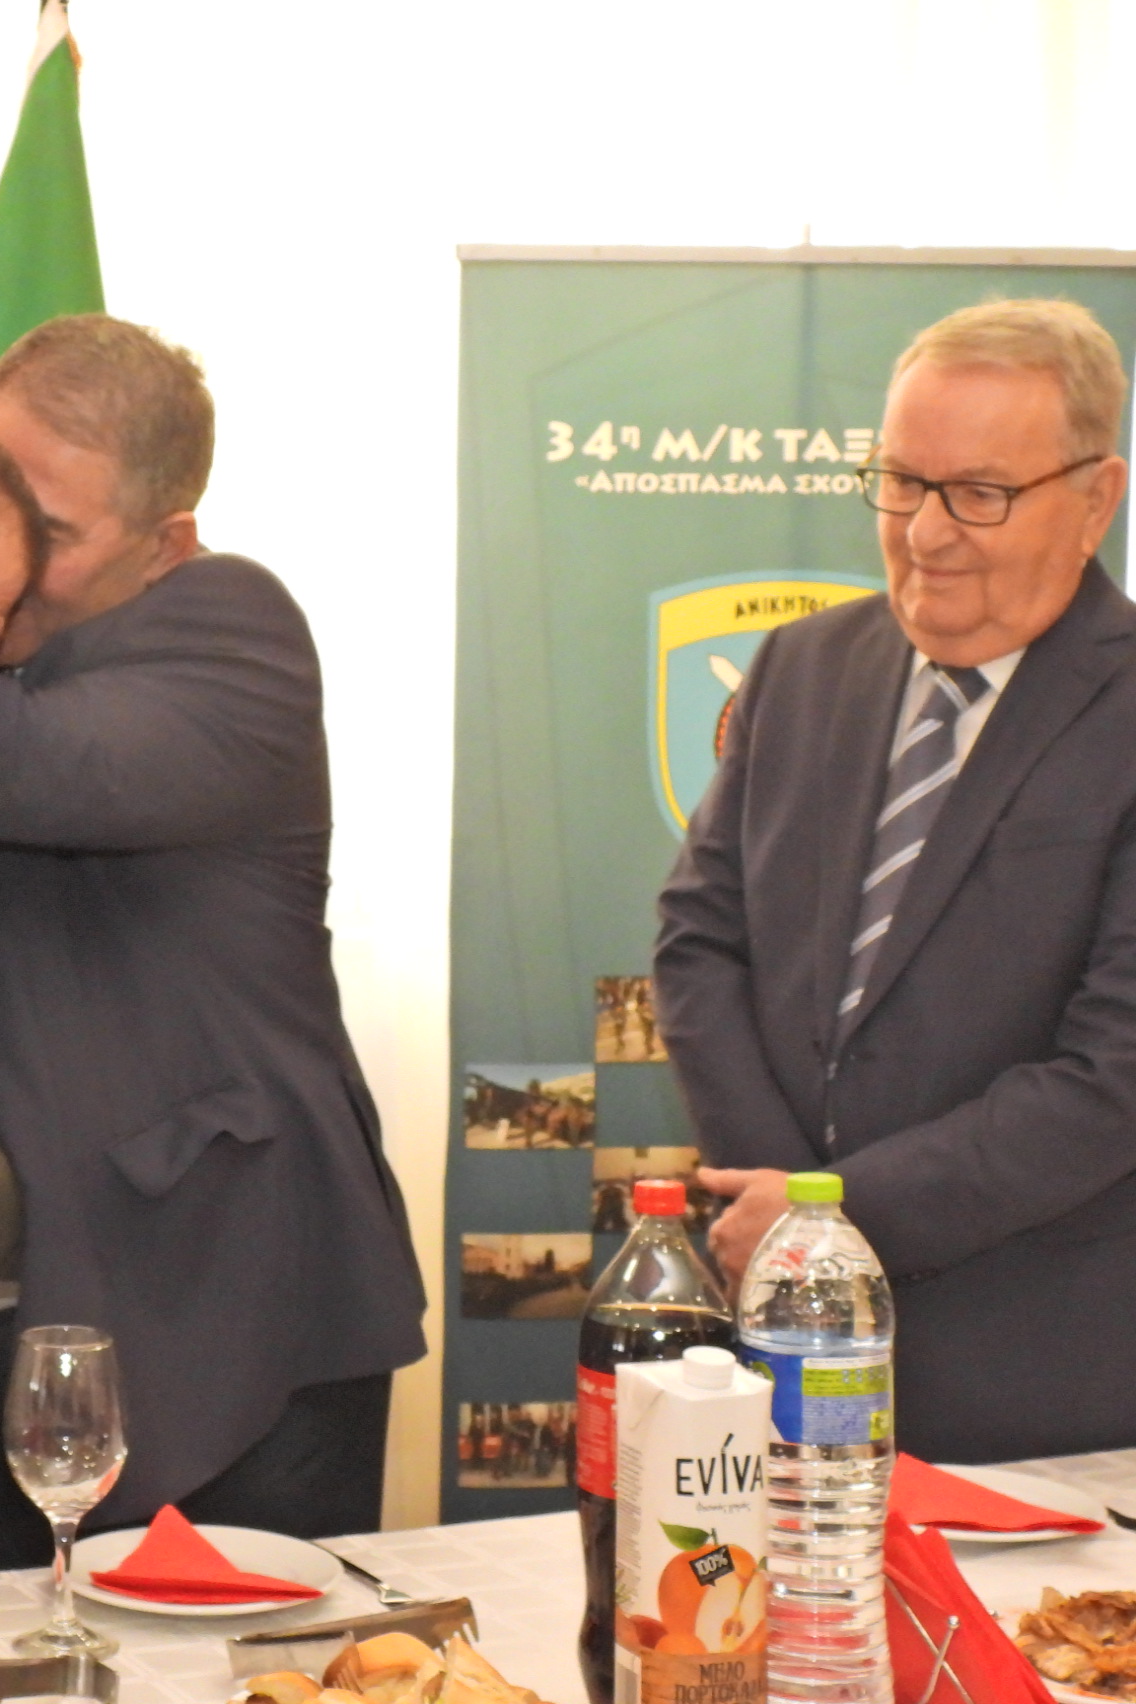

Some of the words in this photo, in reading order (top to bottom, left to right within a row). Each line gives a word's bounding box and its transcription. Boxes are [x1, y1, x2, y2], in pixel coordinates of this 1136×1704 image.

[651, 424, 763, 463] Μ/Κ
[773, 428, 882, 463] ΤΑΞ
[574, 469, 787, 494] «ΑΠΟΣΠΑΣΜΑ
